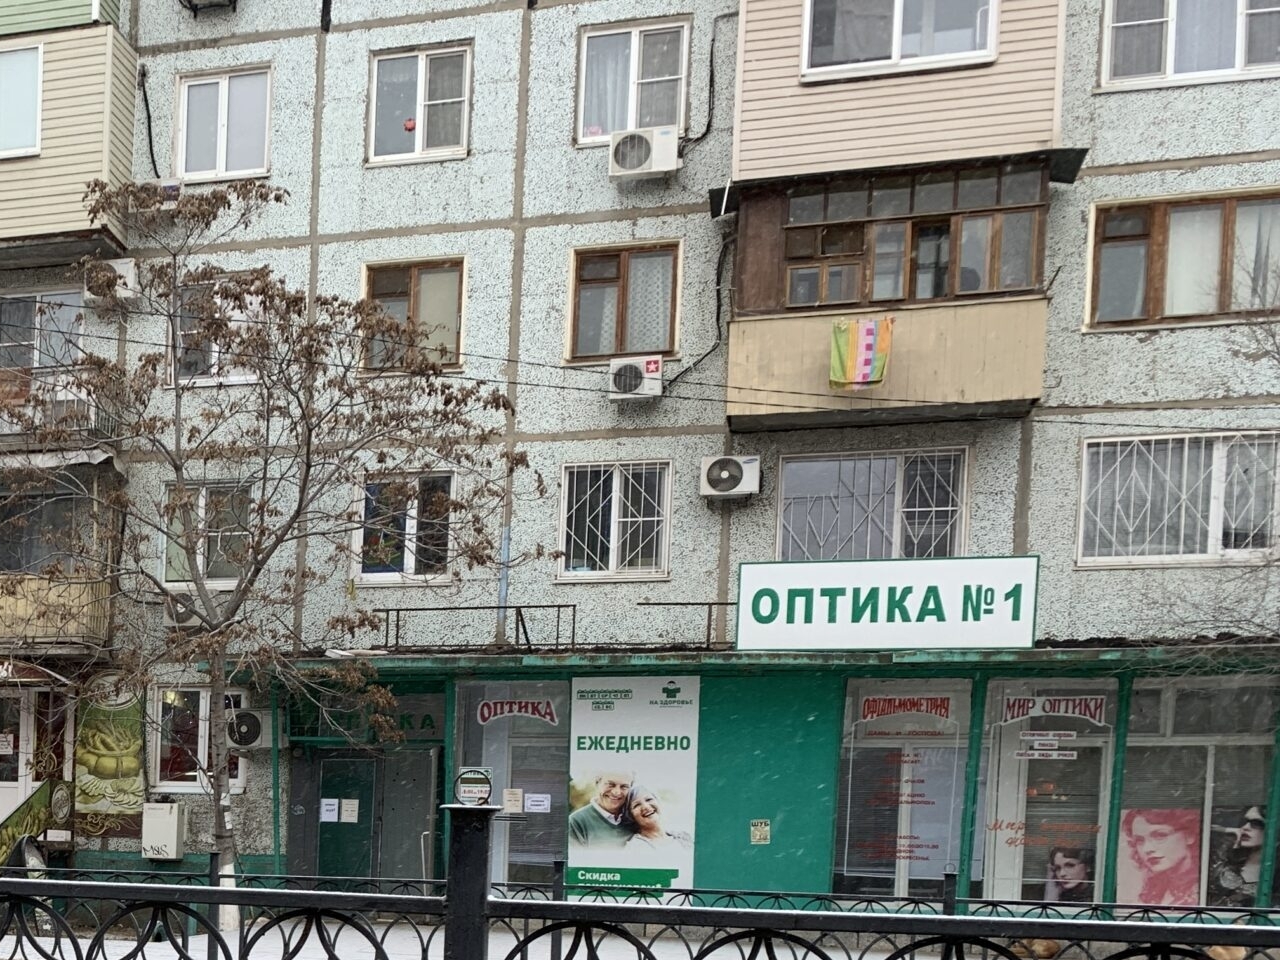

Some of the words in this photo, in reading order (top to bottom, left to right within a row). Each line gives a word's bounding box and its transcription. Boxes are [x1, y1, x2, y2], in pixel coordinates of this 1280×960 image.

[751, 585, 946, 624] ОПТИКА
[478, 700, 558, 725] ОПТИКА
[1004, 698, 1036, 722] МИР
[1042, 697, 1105, 724] ОПТИКИ
[576, 735, 691, 753] ЕЖЕДНЕВНО
[577, 870, 621, 883] Скидка
